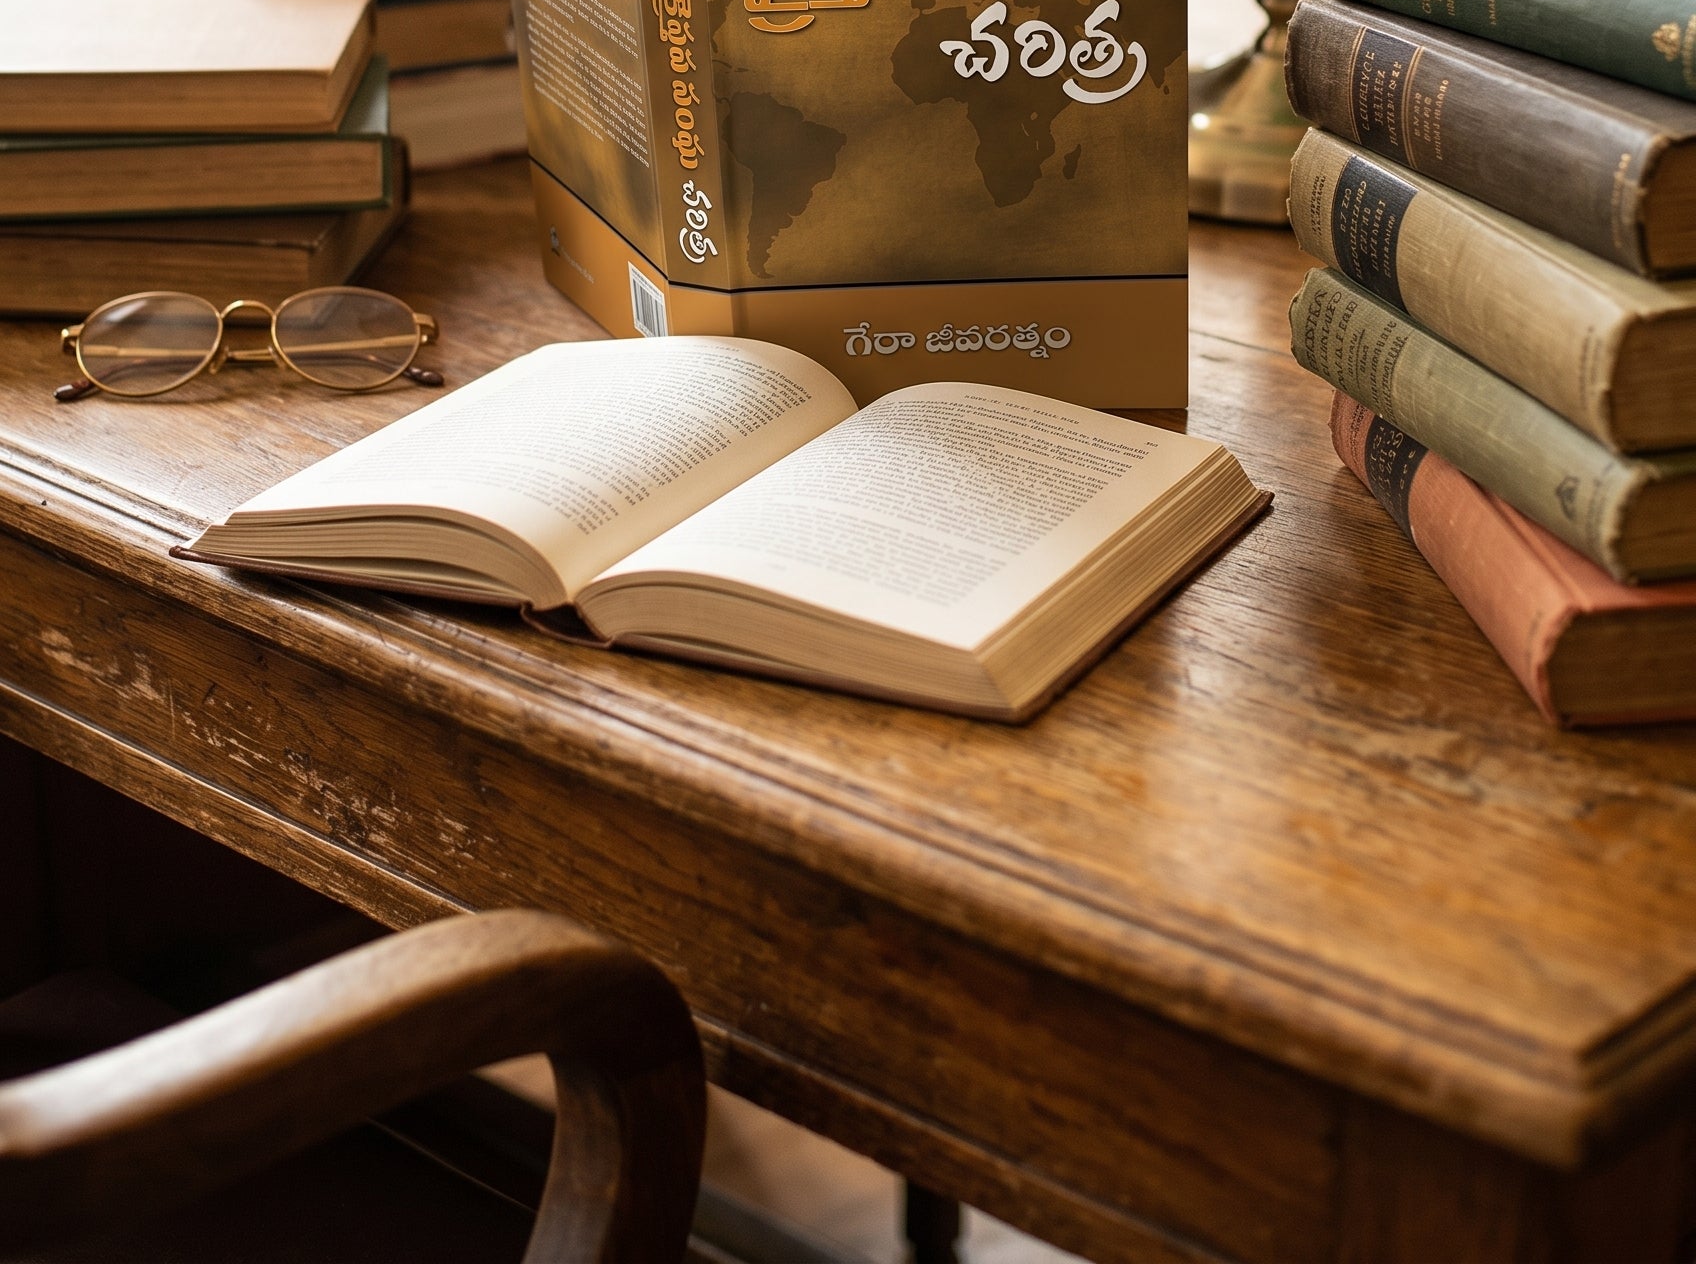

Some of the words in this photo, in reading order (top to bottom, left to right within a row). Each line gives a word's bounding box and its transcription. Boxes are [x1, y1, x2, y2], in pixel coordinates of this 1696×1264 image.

[679, 178, 719, 265] చరిత్ర
[842, 321, 917, 357] గేరా
[925, 322, 1072, 360] జీవరత్నం
